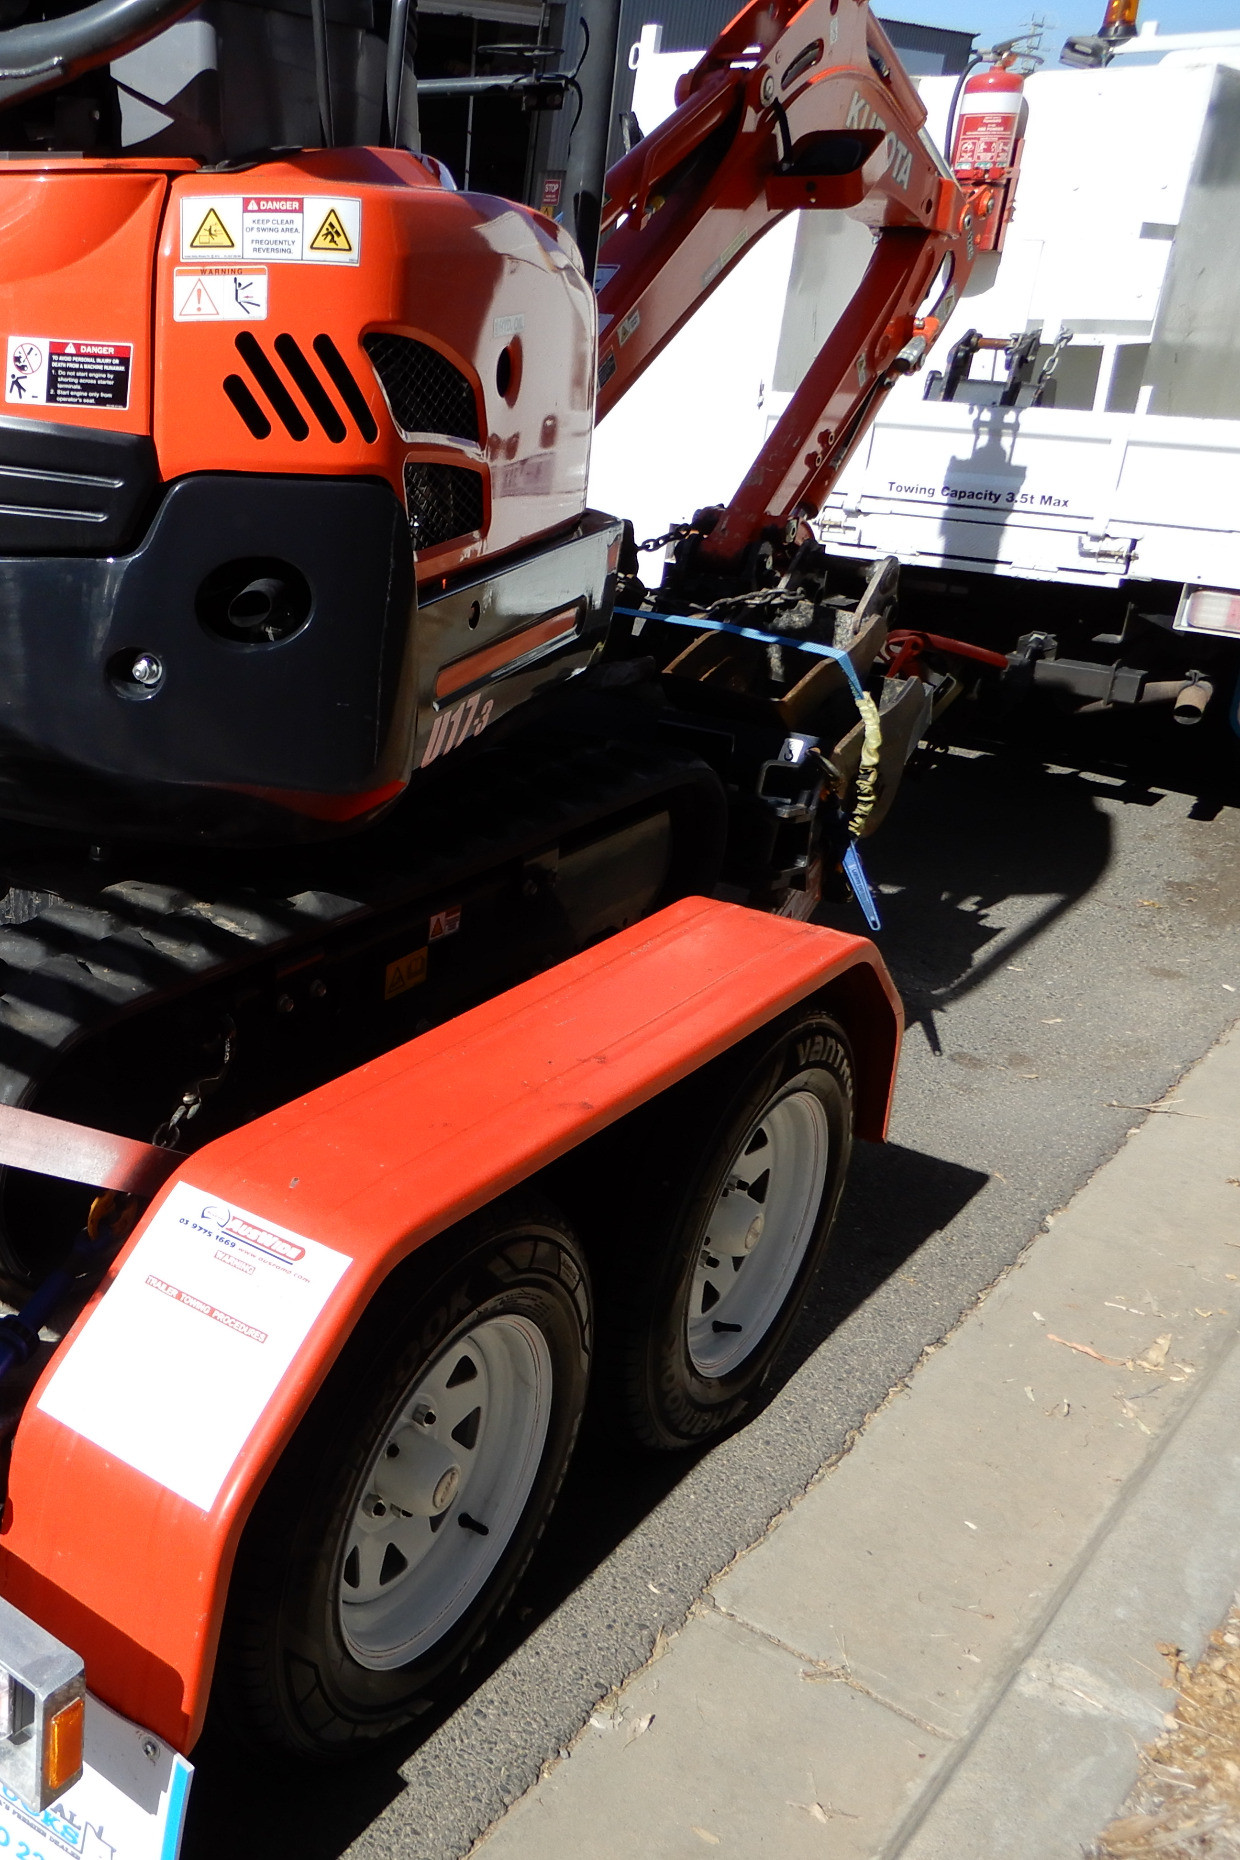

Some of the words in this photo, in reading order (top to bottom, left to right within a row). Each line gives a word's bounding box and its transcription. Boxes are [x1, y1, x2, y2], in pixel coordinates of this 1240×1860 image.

[544, 183, 559, 192] STOP
[260, 201, 299, 210] DANGER
[80, 345, 115, 355] DANGER
[888, 481, 936, 497] Towing
[941, 486, 1002, 504] Capacity
[1006, 492, 1035, 505] 3.5t
[1039, 495, 1070, 508] Max
[420, 692, 494, 769] U17-3
[179, 1217, 190, 1226] 03
[192, 1222, 213, 1238] 9775
[215, 1234, 237, 1249] 1669
[146, 1275, 179, 1300] TRAILER
[180, 1291, 212, 1317] TOWING
[212, 1309, 268, 1343] PROCEDURES
[12, 1808, 47, 1838] PREMIER
